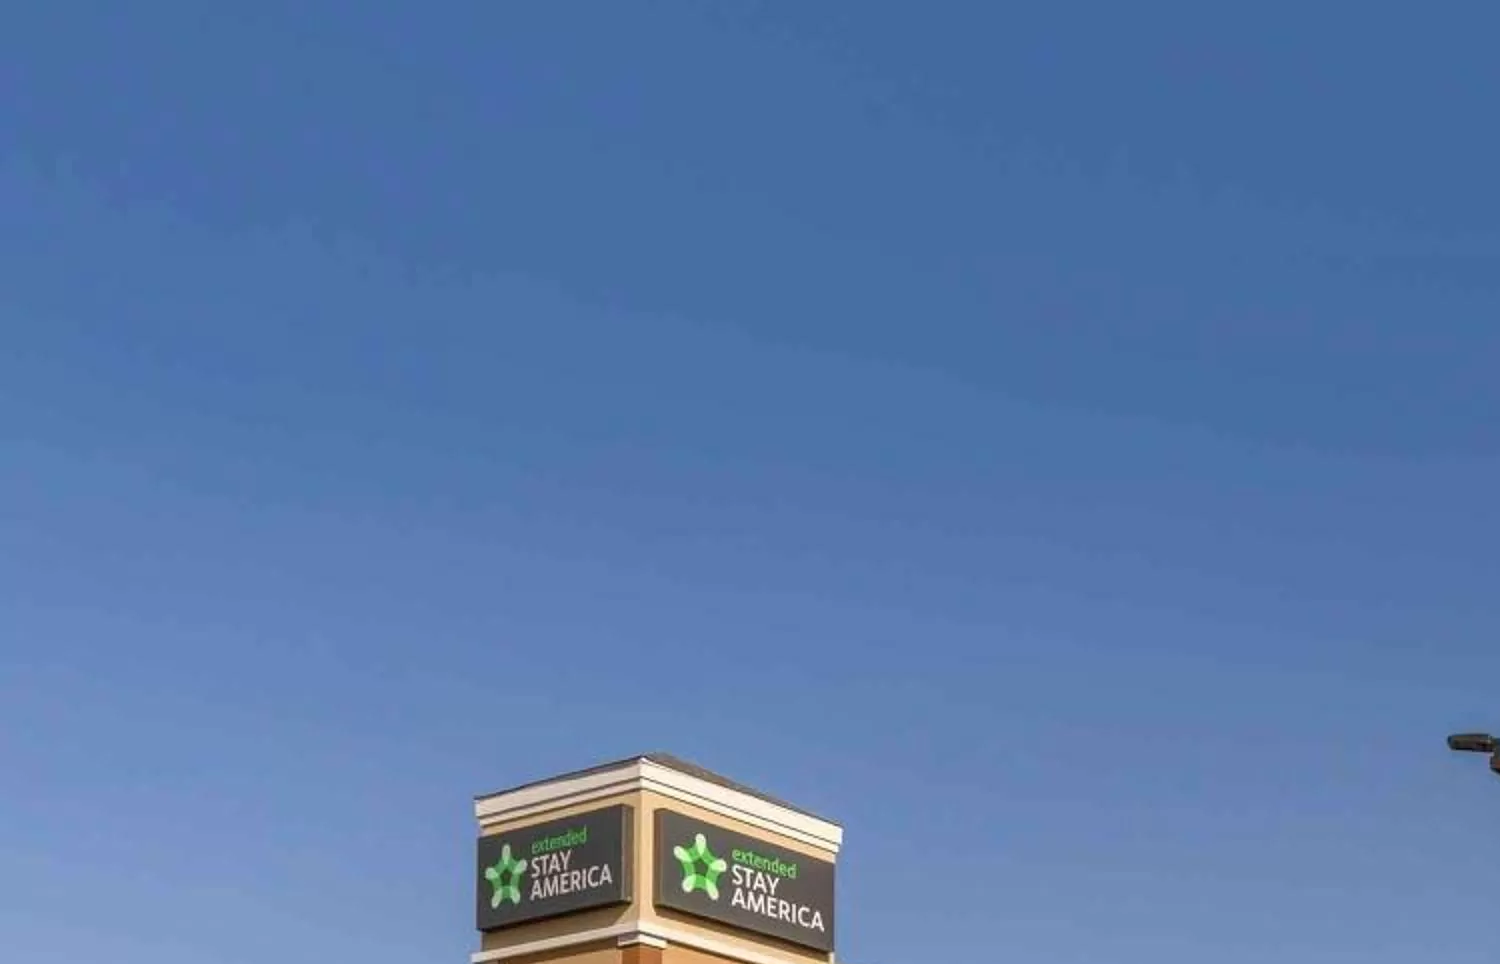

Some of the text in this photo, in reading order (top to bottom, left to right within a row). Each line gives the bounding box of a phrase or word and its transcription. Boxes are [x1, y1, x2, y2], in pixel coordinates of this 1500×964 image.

[531, 825, 588, 852] extended
[531, 850, 573, 878] STAY
[731, 848, 798, 879] extended
[530, 863, 613, 901] AMERICA
[731, 864, 780, 896] STAY
[731, 887, 826, 933] AMERICA
